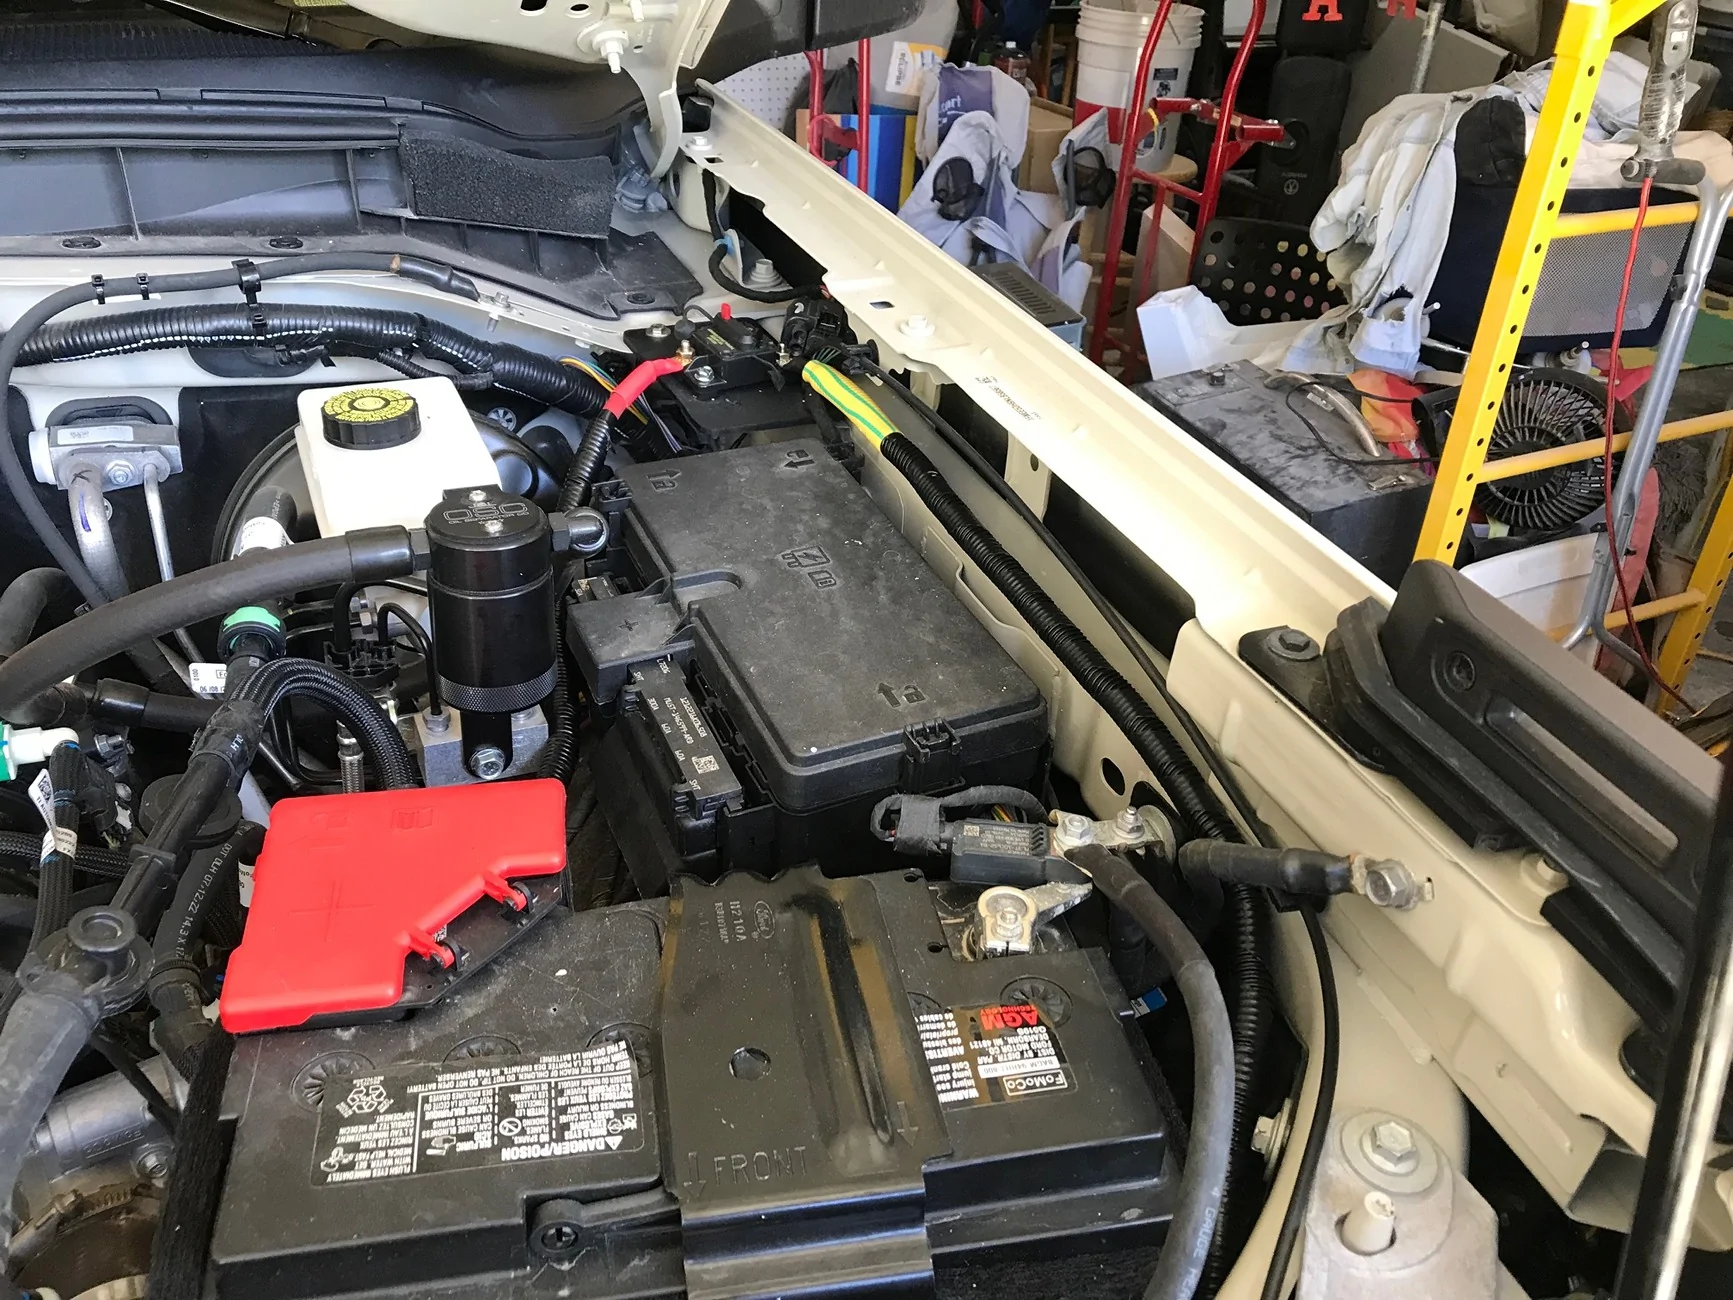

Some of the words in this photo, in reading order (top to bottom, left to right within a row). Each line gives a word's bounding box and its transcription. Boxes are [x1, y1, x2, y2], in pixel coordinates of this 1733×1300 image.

[980, 1004, 1035, 1015] TECHNOLOGY
[980, 1009, 1039, 1030] AGM
[993, 1038, 1003, 1046] MI
[1004, 1032, 1049, 1044] DEARBORN,
[970, 1040, 991, 1049] 48121
[1001, 1043, 1029, 1052] MOTOR
[1031, 1040, 1052, 1049] FORD
[986, 1046, 1000, 1054] CO.
[1024, 1050, 1033, 1058] BY
[1034, 1047, 1055, 1057] DIST.
[977, 1055, 993, 1064] PAR
[995, 1052, 1020, 1061] DISTR.
[573, 1059, 581, 1067] LA
[583, 1057, 591, 1066] DE
[616, 1060, 630, 1070] KEEP
[581, 1066, 592, 1074] THE
[594, 1065, 601, 1073] OF
[604, 1063, 614, 1071] OUT
[478, 1069, 490, 1077] PAS
[492, 1068, 500, 1076] NE
[559, 1068, 579, 1076] REACH
[469, 1078, 478, 1086] DO
[507, 1074, 515, 1082] DO
[1006, 1073, 1063, 1090] FoMoCo
[407, 1083, 436, 1093] BATTERY!
[438, 1080, 454, 1089] OPEN
[456, 1080, 468, 1088] NOT
[521, 1084, 539, 1092] FUMER
[482, 1089, 493, 1097] DES
[424, 1103, 431, 1112] OU
[451, 1100, 457, 1108] LA
[600, 1101, 633, 1110] BLINDNESS
[515, 1109, 525, 1117] LES
[567, 1105, 589, 1114] INJURY
[457, 1116, 481, 1125] SEVERE
[483, 1114, 492, 1123] OR
[560, 1114, 578, 1123] CAUSE
[580, 1112, 591, 1120] CAN
[379, 1119, 414, 1130] CONSULTEZ
[433, 1119, 455, 1129] BURNS
[523, 1117, 548, 1127] SMOKING
[369, 1123, 377, 1131] UN
[458, 1124, 478, 1134] CAUSE
[479, 1122, 492, 1132] CAN
[422, 1127, 456, 1138] BLINDNESS
[474, 1130, 492, 1141] ACID
[391, 1136, 413, 1146] RINCEZ
[540, 1133, 549, 1142] NO
[360, 1140, 376, 1149] YEUX
[378, 1139, 389, 1147] LES
[456, 1138, 492, 1151] SULFURIC
[384, 1147, 412, 1157] MEDICAL
[502, 1137, 605, 1161] DANGER/POISON
[371, 1150, 384, 1159] HELP
[394, 1156, 411, 1165] WITH
[355, 1161, 367, 1170] GET
[390, 1165, 410, 1175] FLUSH
[714, 1146, 806, 1187] FRONT
[327, 1169, 371, 1182] IMMEDIATELY
[373, 1167, 388, 1177] EYES
[1193, 1207, 1216, 1262] GAUGE
